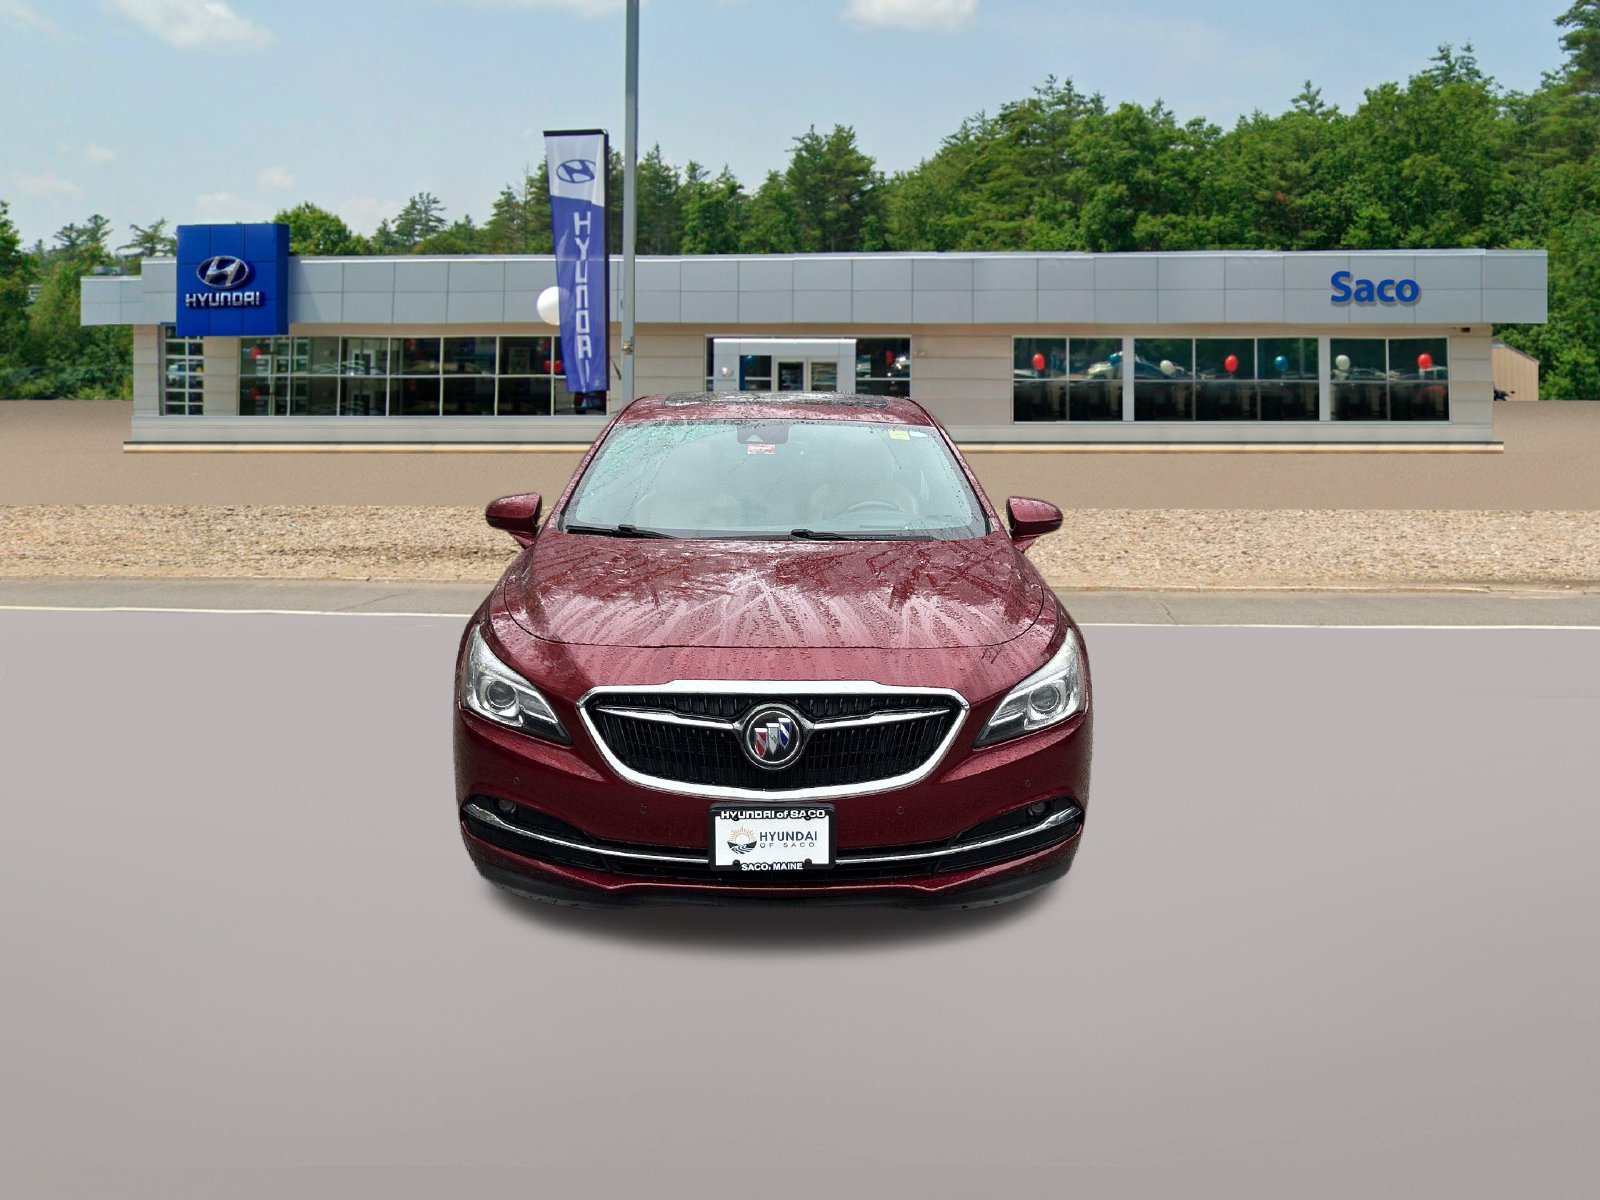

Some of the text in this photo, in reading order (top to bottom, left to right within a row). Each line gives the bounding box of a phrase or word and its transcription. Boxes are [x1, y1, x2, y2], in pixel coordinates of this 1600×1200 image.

[1330, 270, 1420, 303] Saco
[185, 291, 260, 307] HYUNDAI
[573, 211, 592, 384] HYUNDAI
[720, 809, 826, 819] HYUNDAI of SACO
[759, 831, 818, 842] HYUNDAI
[741, 862, 804, 871] SACO, MAINE
